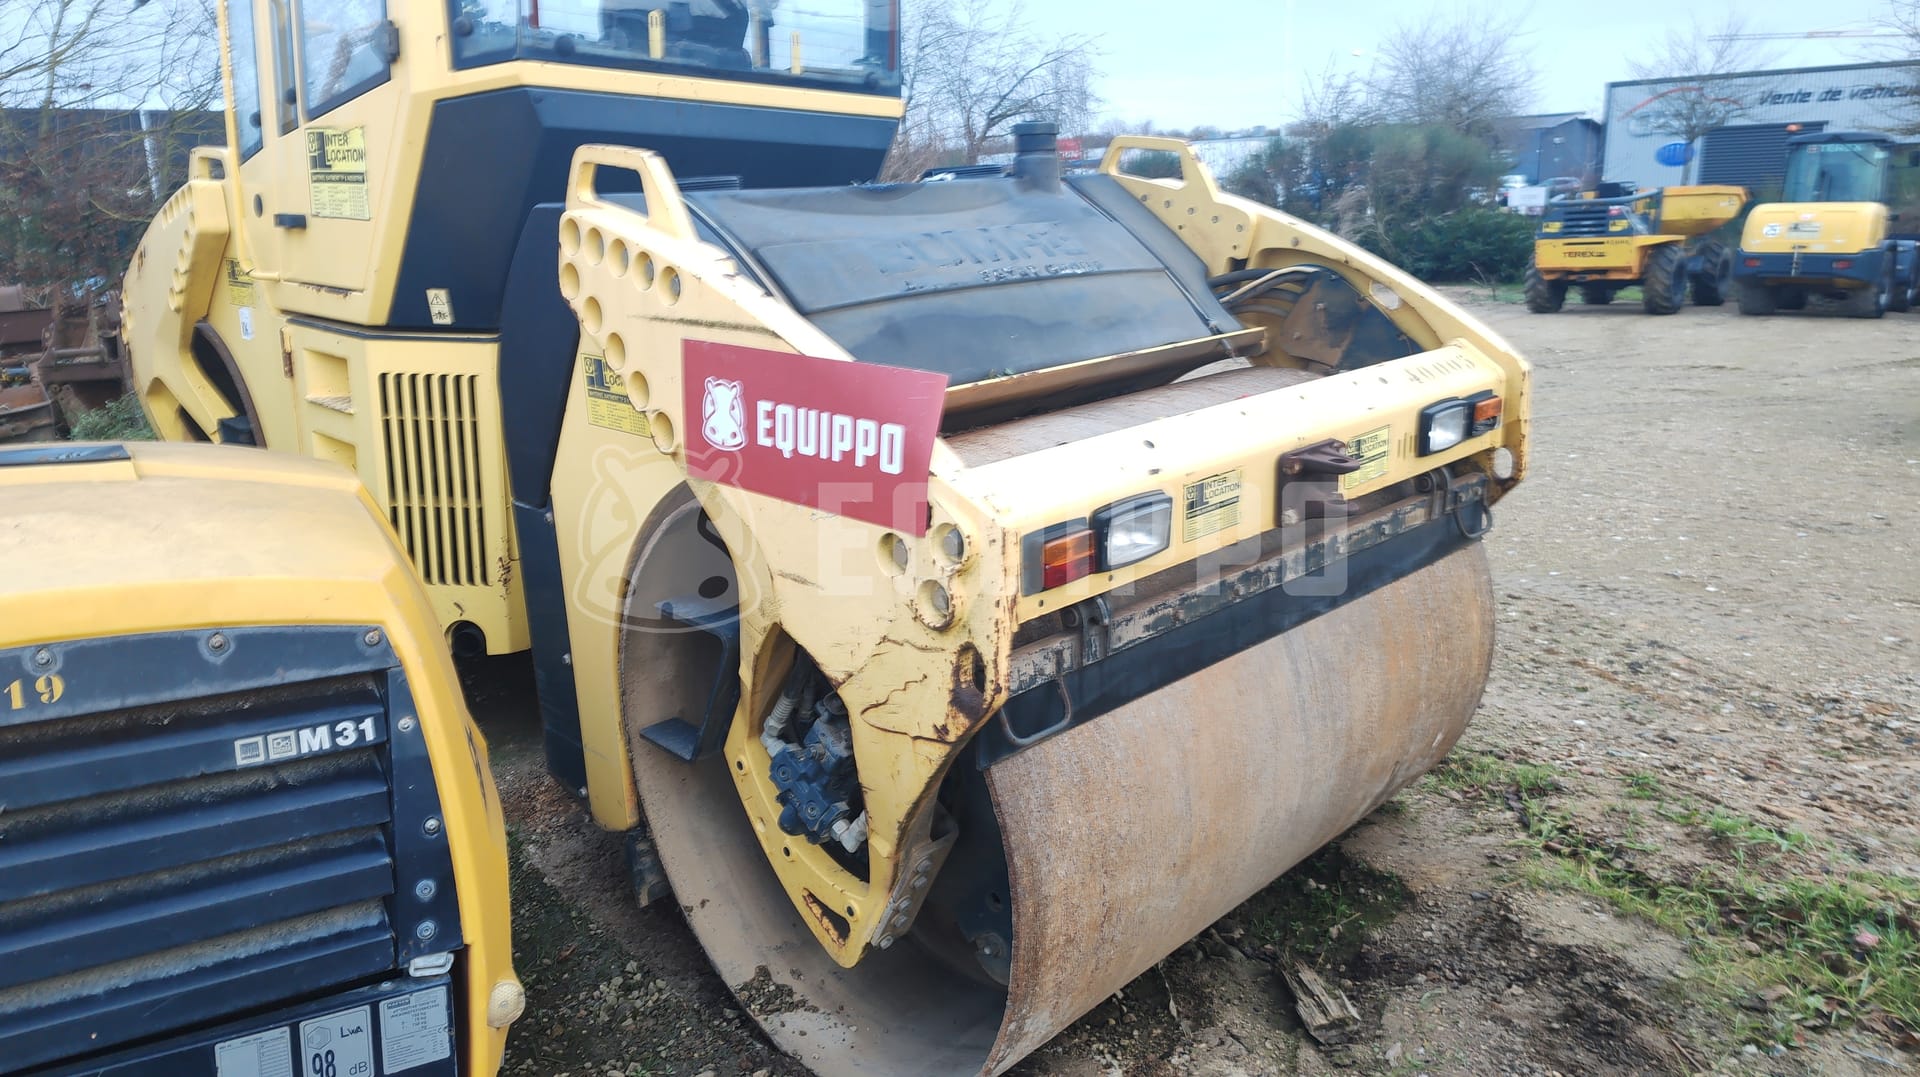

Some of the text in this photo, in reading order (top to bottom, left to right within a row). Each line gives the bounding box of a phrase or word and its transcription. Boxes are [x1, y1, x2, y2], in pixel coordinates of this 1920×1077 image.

[1760, 87, 1813, 105] Vente
[1816, 86, 1842, 102] de
[325, 133, 349, 148] INTER
[326, 149, 364, 163] LOCATION
[756, 399, 905, 475] EQUIPPO
[1205, 476, 1227, 490] INTER
[1205, 481, 1241, 500] LOCATION
[312, 1049, 336, 1077] 98
[349, 1061, 368, 1076] dB
